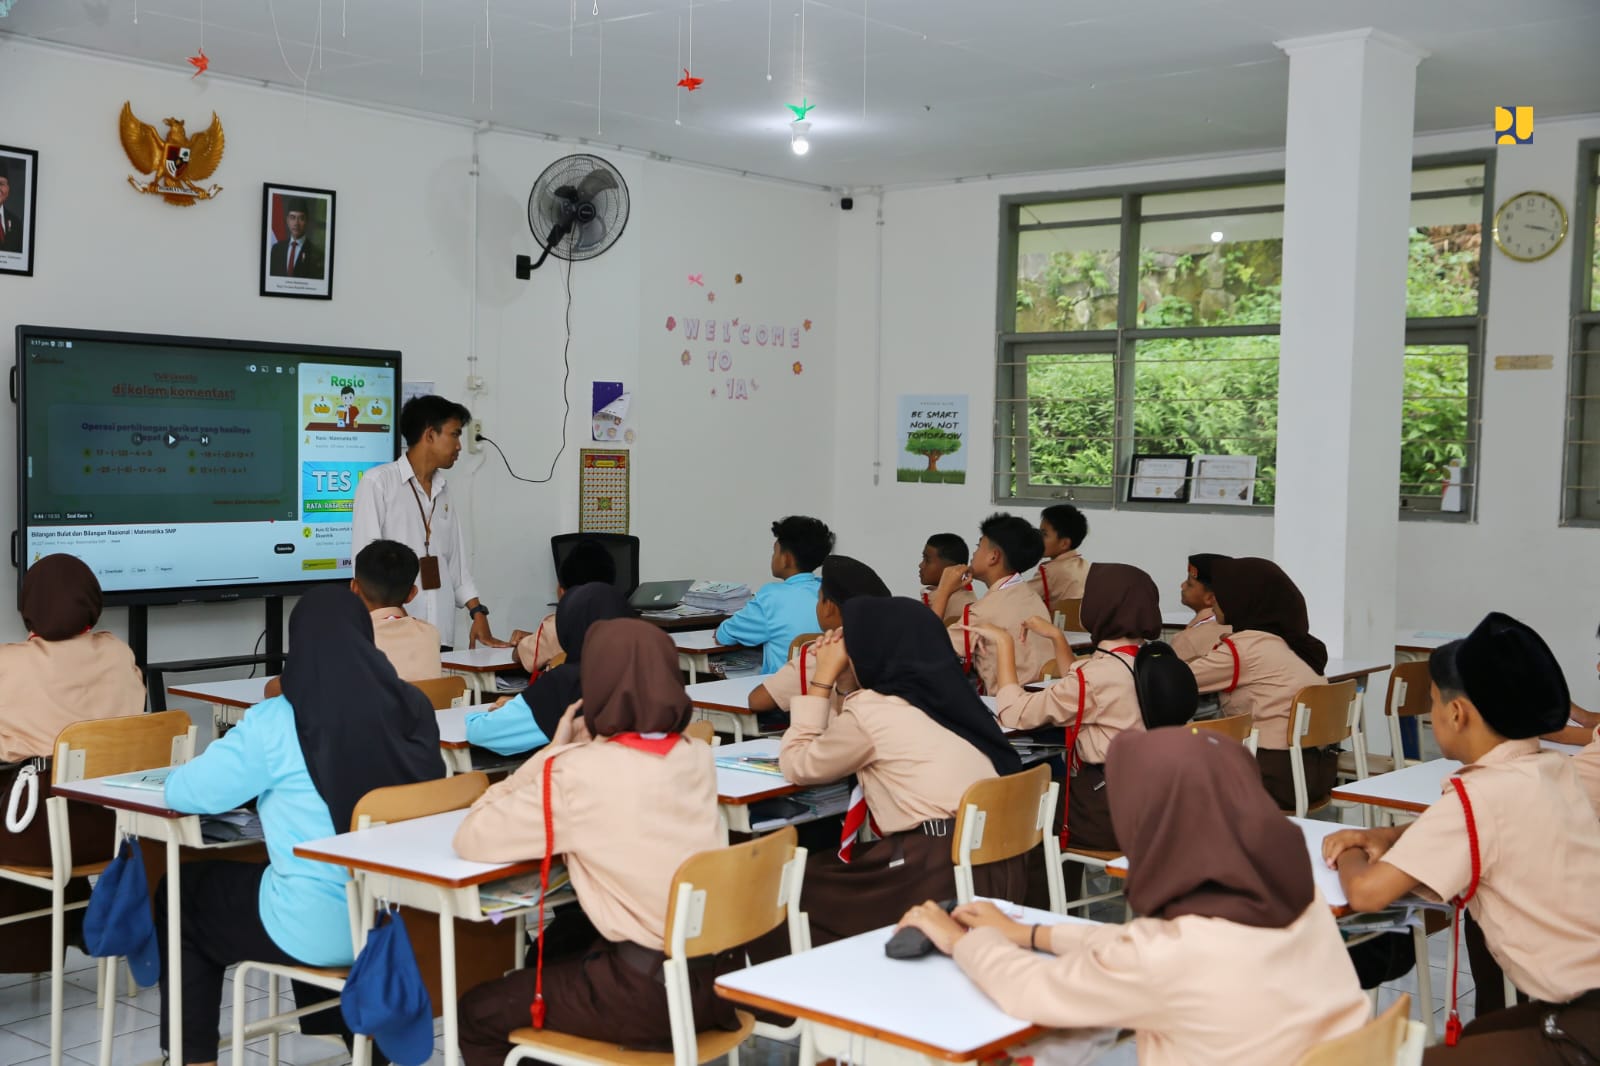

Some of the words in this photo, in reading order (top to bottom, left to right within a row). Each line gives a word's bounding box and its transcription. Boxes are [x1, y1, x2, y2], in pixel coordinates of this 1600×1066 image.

[683, 318, 800, 349] WELCOME
[707, 350, 732, 372] TO
[331, 374, 365, 388] Rasio
[112, 384, 125, 395] di
[127, 384, 168, 397] kolom
[726, 378, 748, 400] 1A
[927, 411, 959, 419] SMART
[81, 422, 115, 432] Operasi
[117, 423, 168, 433] perhitungan
[910, 421, 934, 430] NOW,
[937, 421, 960, 429] NOT
[907, 431, 962, 440] TOMORROW
[312, 470, 352, 492] TES
[31, 531, 56, 539] Bilangan
